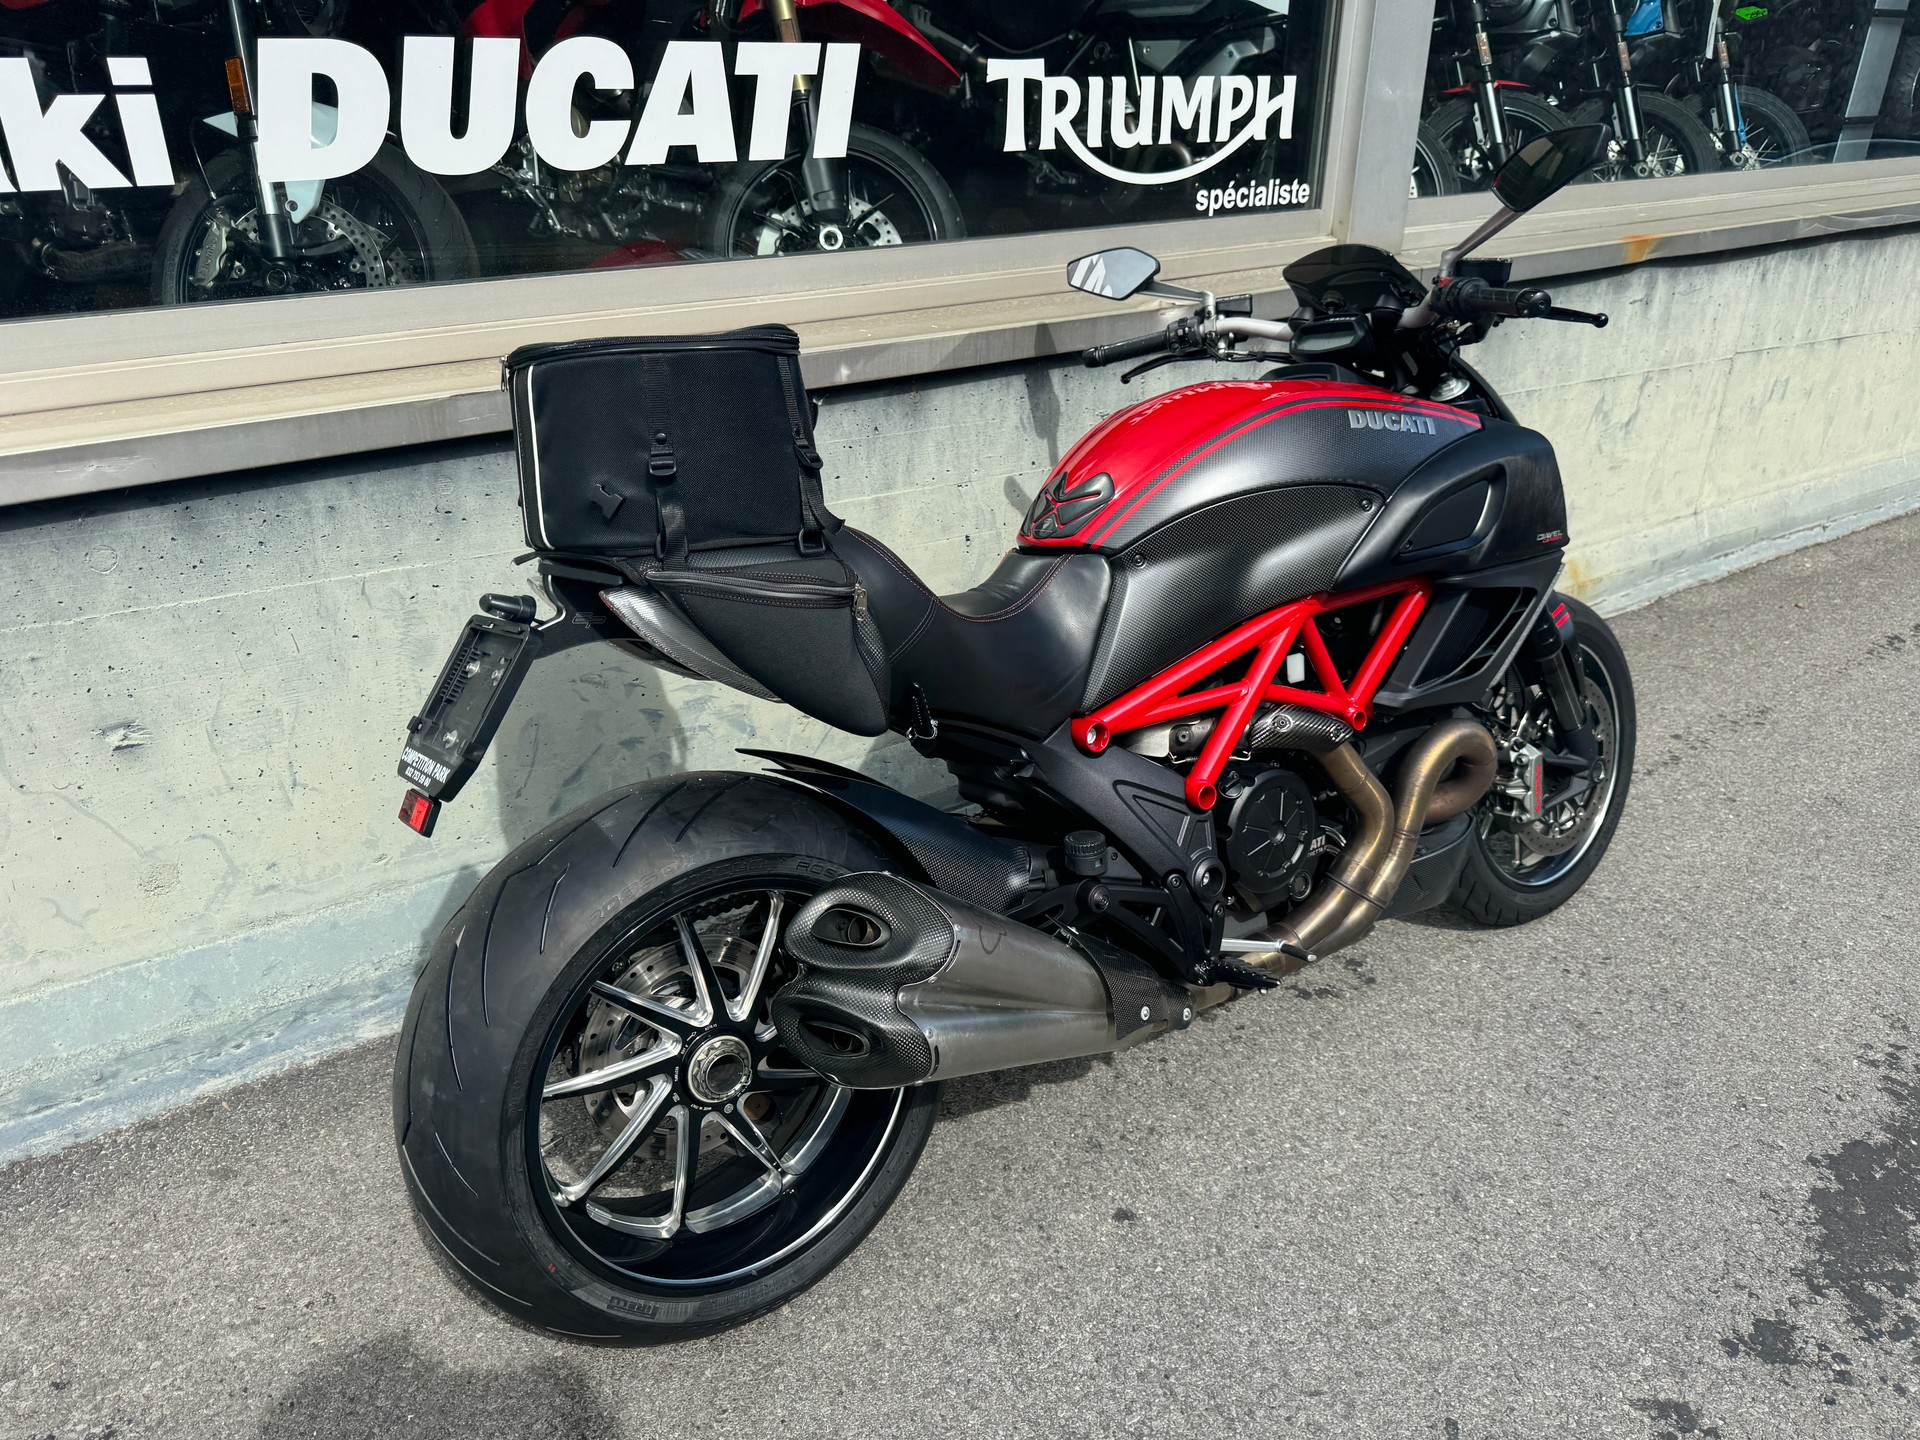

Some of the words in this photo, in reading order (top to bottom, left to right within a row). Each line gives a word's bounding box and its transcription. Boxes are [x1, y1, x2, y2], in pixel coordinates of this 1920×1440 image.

[0, 57, 175, 192] ki
[257, 37, 860, 182] DUCATI
[986, 58, 1297, 184] TRIUMPH
[1195, 178, 1310, 217] spécialiste
[1347, 409, 1437, 435] DUCATI
[401, 746, 436, 776] COMPETITION
[432, 763, 451, 784] PARK
[796, 860, 842, 880] ROS
